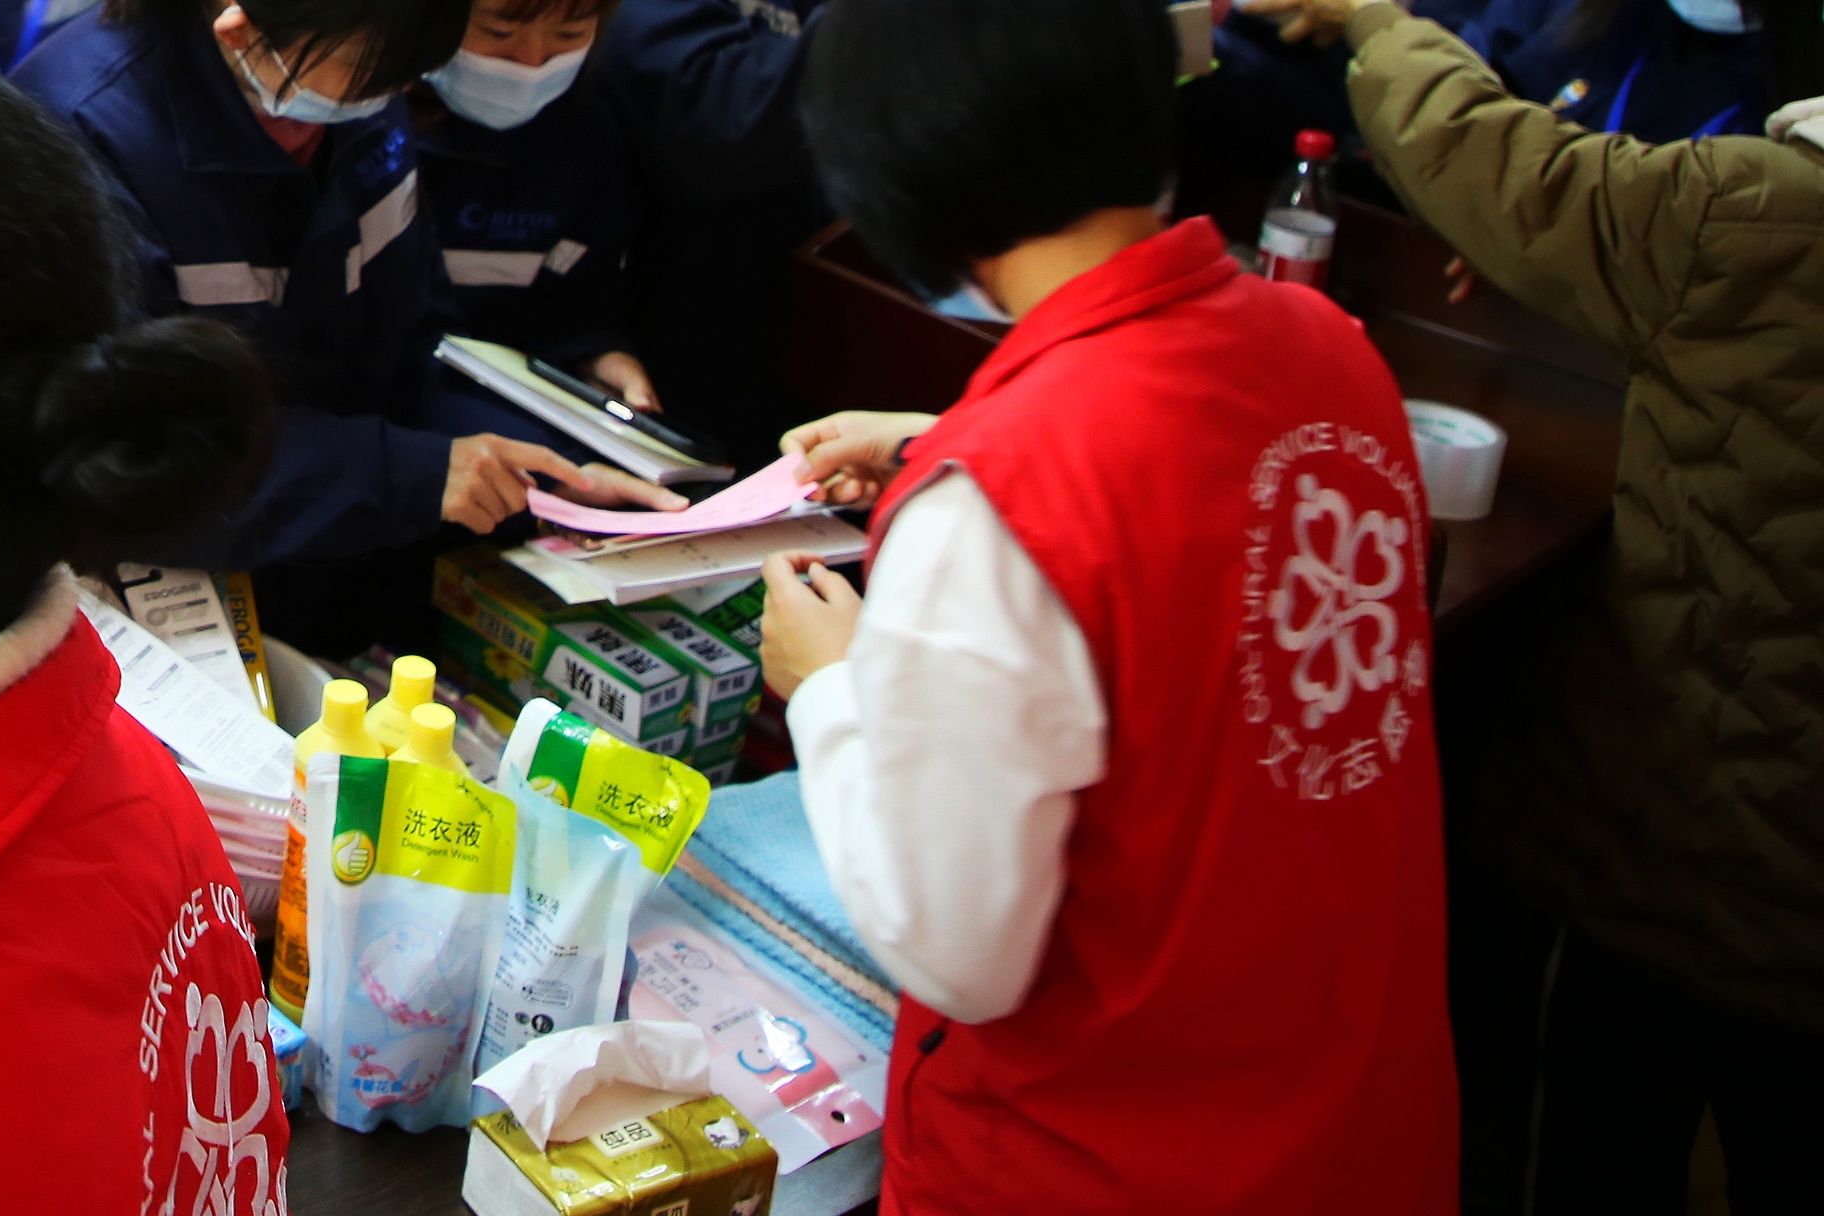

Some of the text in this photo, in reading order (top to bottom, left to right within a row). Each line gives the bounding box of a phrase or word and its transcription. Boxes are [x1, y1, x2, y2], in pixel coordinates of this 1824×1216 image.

[1248, 421, 1338, 511] SERVICE
[564, 657, 627, 722] 黑妹
[403, 807, 482, 849] 洗衣液
[596, 780, 677, 829] 洗衣液
[450, 846, 480, 864] Wash
[139, 887, 210, 1082] SERVICE
